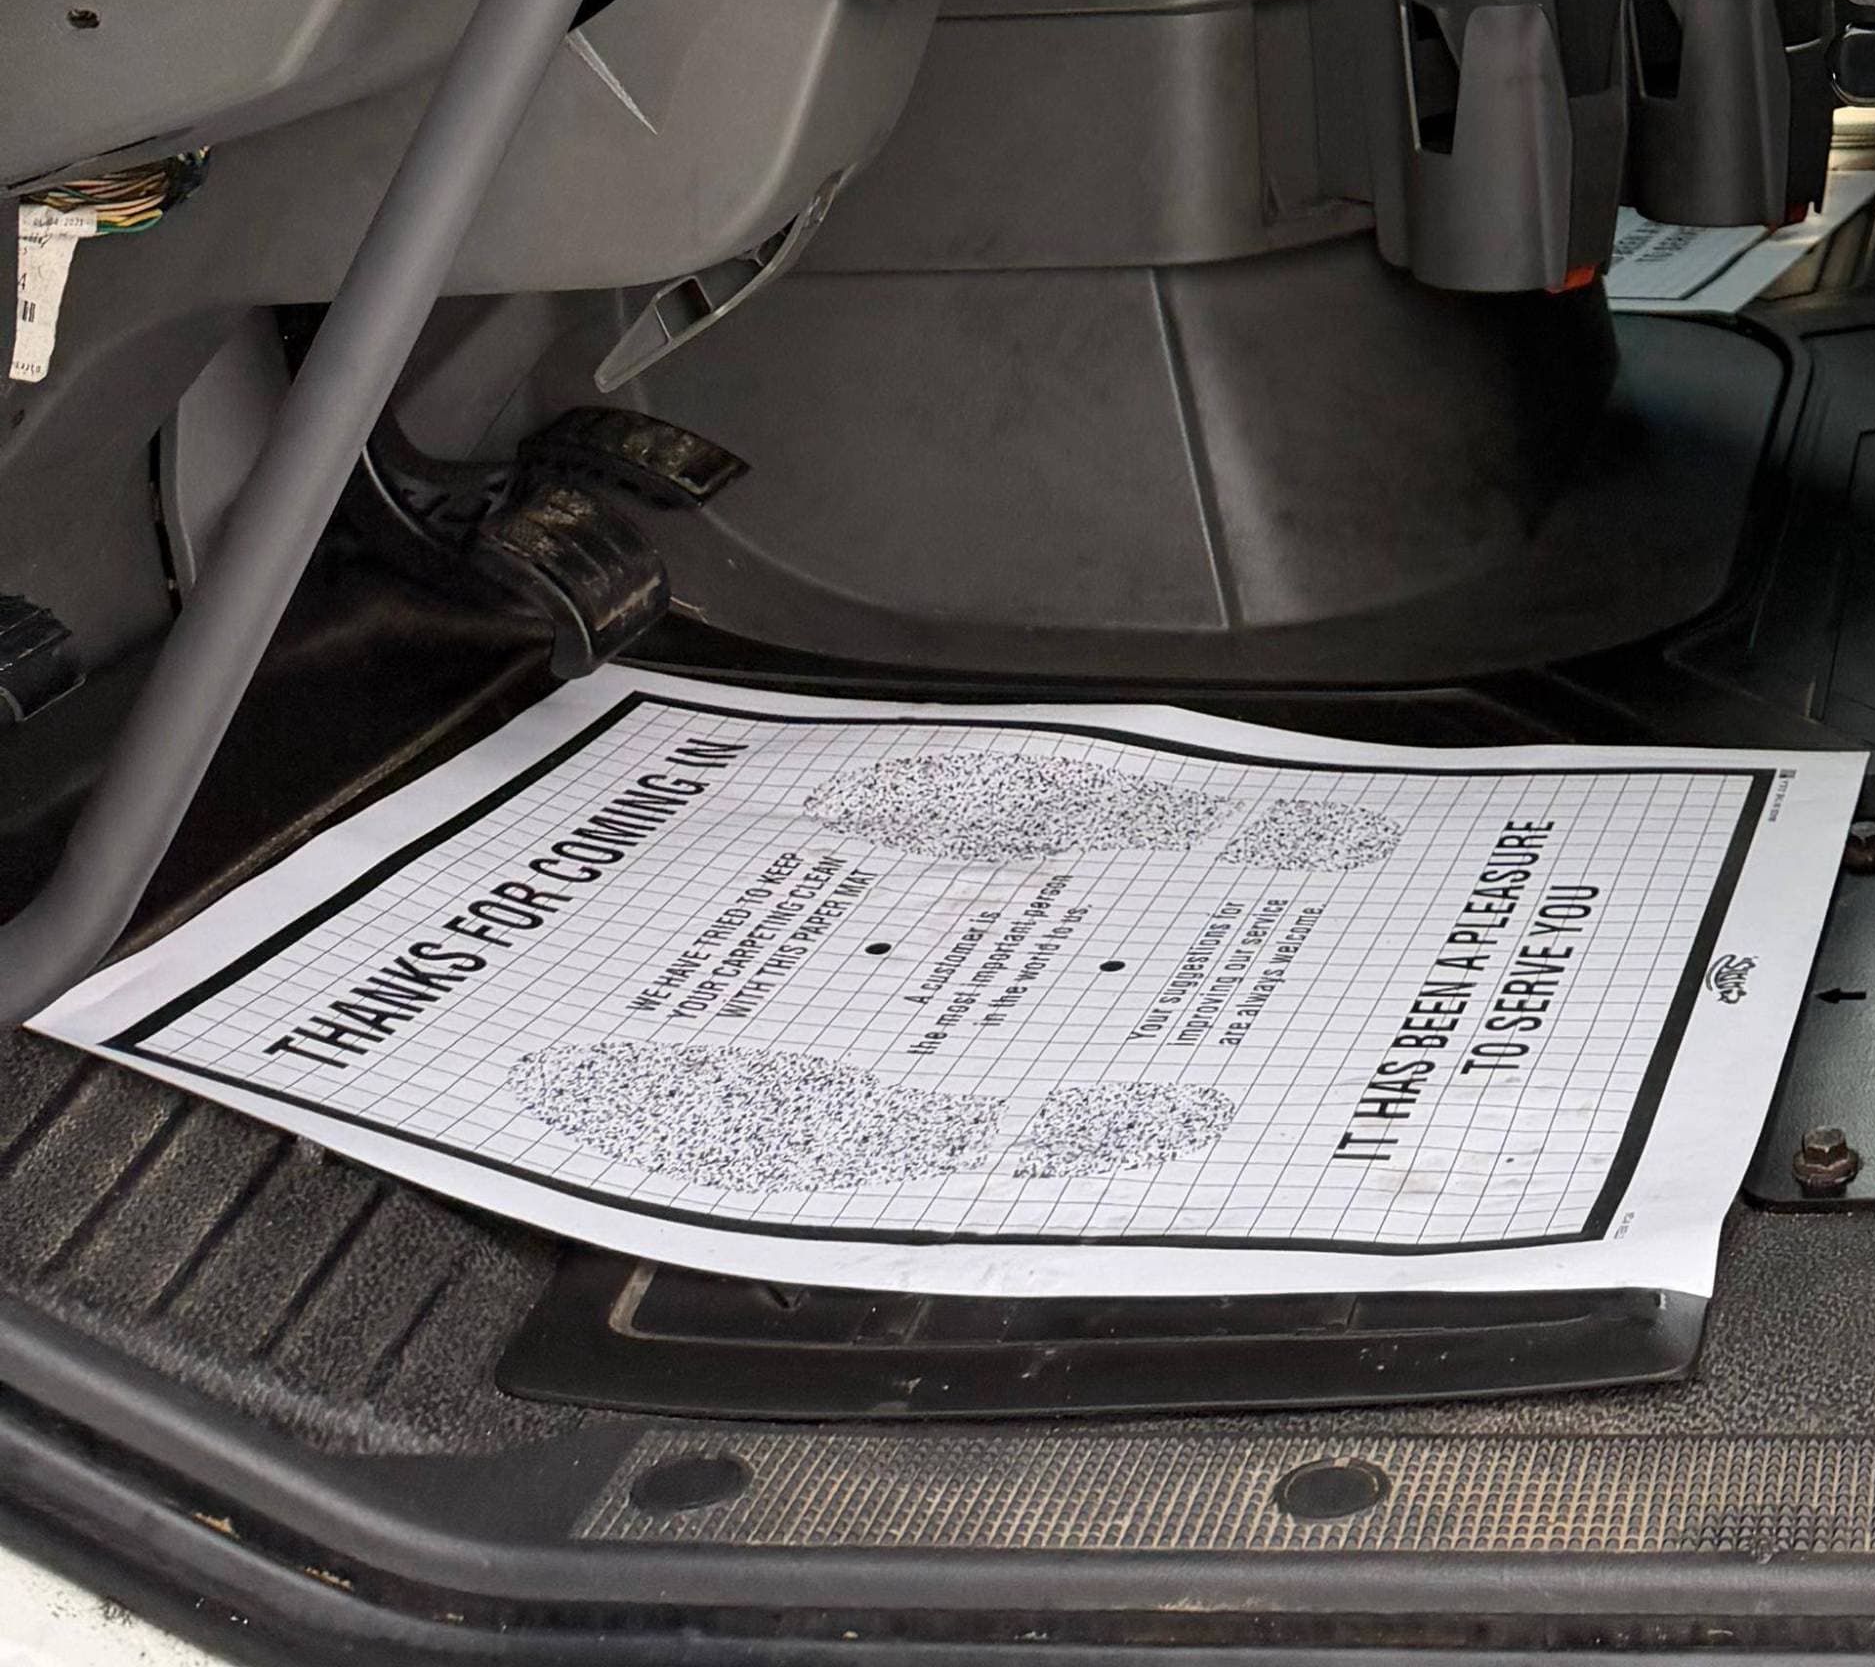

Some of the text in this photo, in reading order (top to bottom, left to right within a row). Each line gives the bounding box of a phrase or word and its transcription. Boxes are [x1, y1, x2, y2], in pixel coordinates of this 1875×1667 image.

[263, 738, 750, 1069] THANKS FOR COMING IN
[626, 852, 804, 1011] WE HAVE TRIED TO KEEP
[666, 855, 848, 1019] YOUR CARPETING CLEAN
[716, 869, 878, 1018] WITH THIS PAPER MAT
[904, 911, 1001, 1005] A customer is
[907, 874, 1074, 1055] the most important person
[973, 904, 1092, 1026] in the world to us.
[1126, 901, 1245, 1040] Your suggestions for
[1166, 899, 1288, 1046] improving our service
[1219, 903, 1327, 1046] are always welcome.
[1461, 885, 1599, 1075] TO SERVE YOU
[1332, 821, 1555, 1161] IT HAS BEEN A PLEASURE
